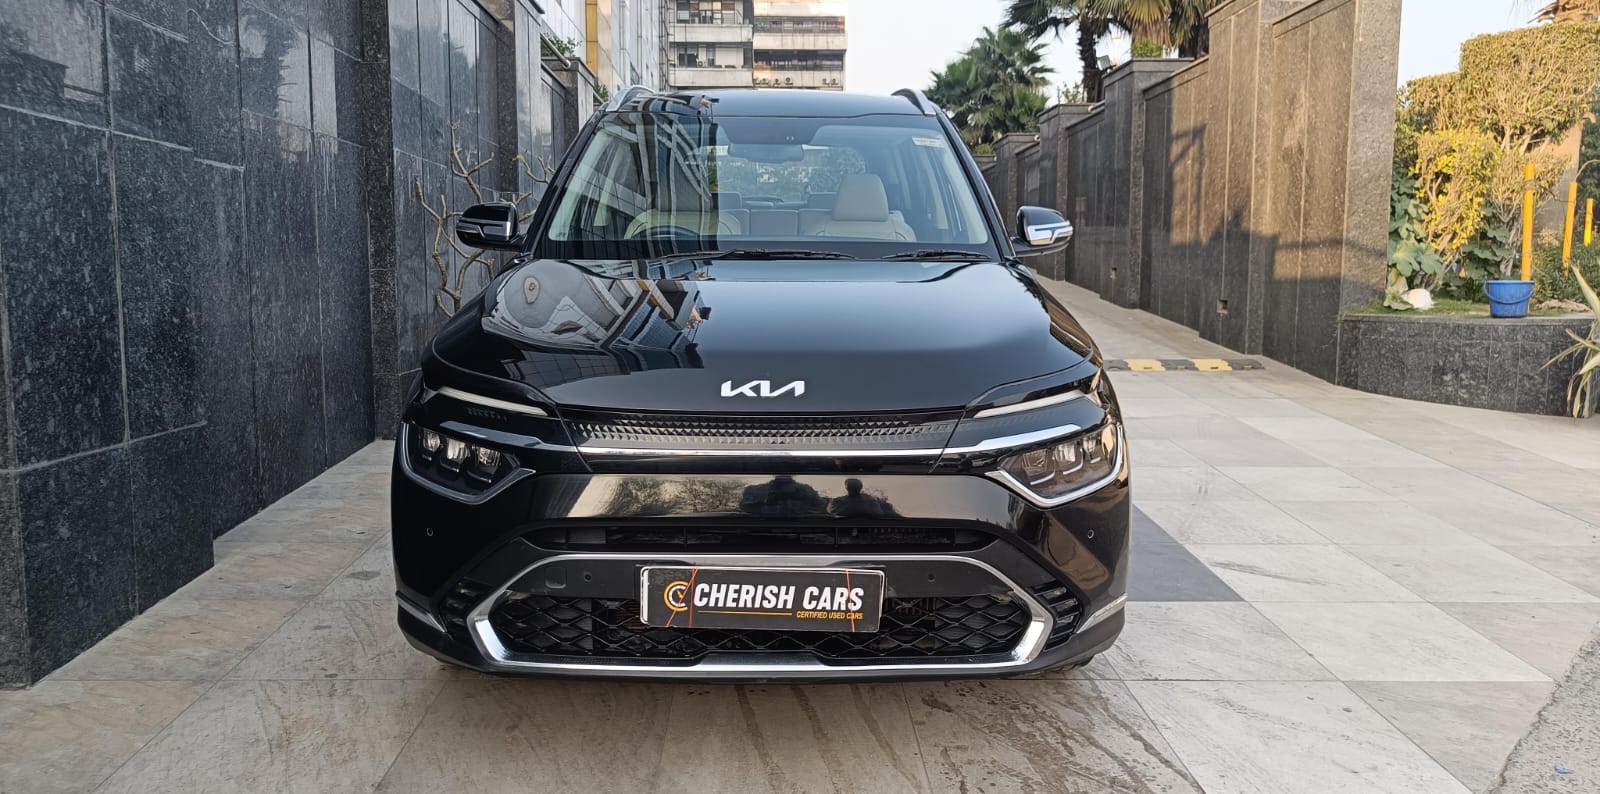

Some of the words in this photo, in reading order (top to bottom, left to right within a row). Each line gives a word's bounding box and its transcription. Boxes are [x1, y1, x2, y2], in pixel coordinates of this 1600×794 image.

[720, 379, 805, 397] KIA
[694, 583, 796, 608] CHERISH
[803, 586, 864, 610] CARS
[796, 611, 828, 619] CERTIFIED
[828, 612, 845, 620] USED
[846, 612, 863, 620] CARS
